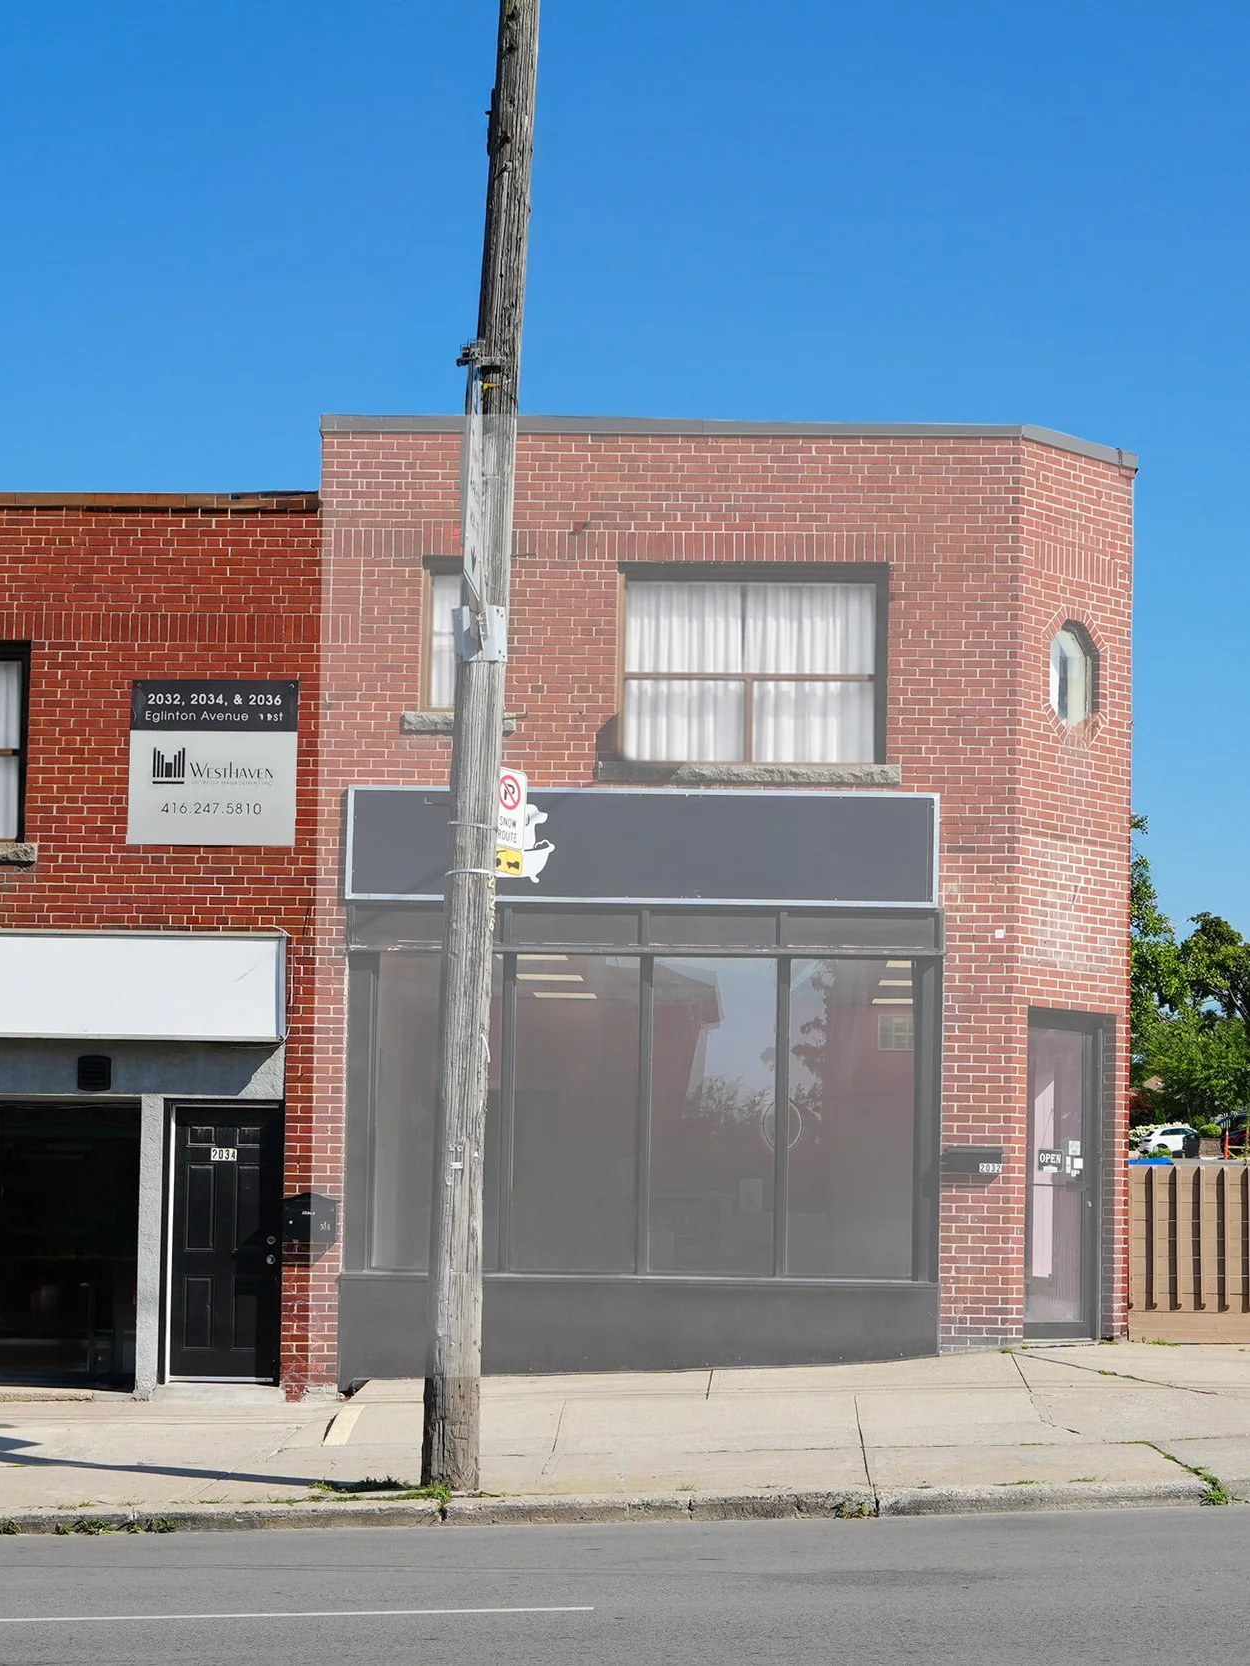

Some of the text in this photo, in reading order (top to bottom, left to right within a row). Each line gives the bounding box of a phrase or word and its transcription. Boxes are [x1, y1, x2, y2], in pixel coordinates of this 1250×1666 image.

[148, 693, 282, 707] 2032, 2034, & 2036
[145, 710, 197, 723] Eglinton
[200, 710, 249, 721] Avenue
[161, 802, 262, 815] 416.247.5810
[499, 815, 518, 829] SNOW
[497, 828, 518, 844] ROUTE
[212, 1148, 236, 1160] 2034
[1039, 1152, 1062, 1164] OPEN
[980, 1163, 1001, 1173] 2032
